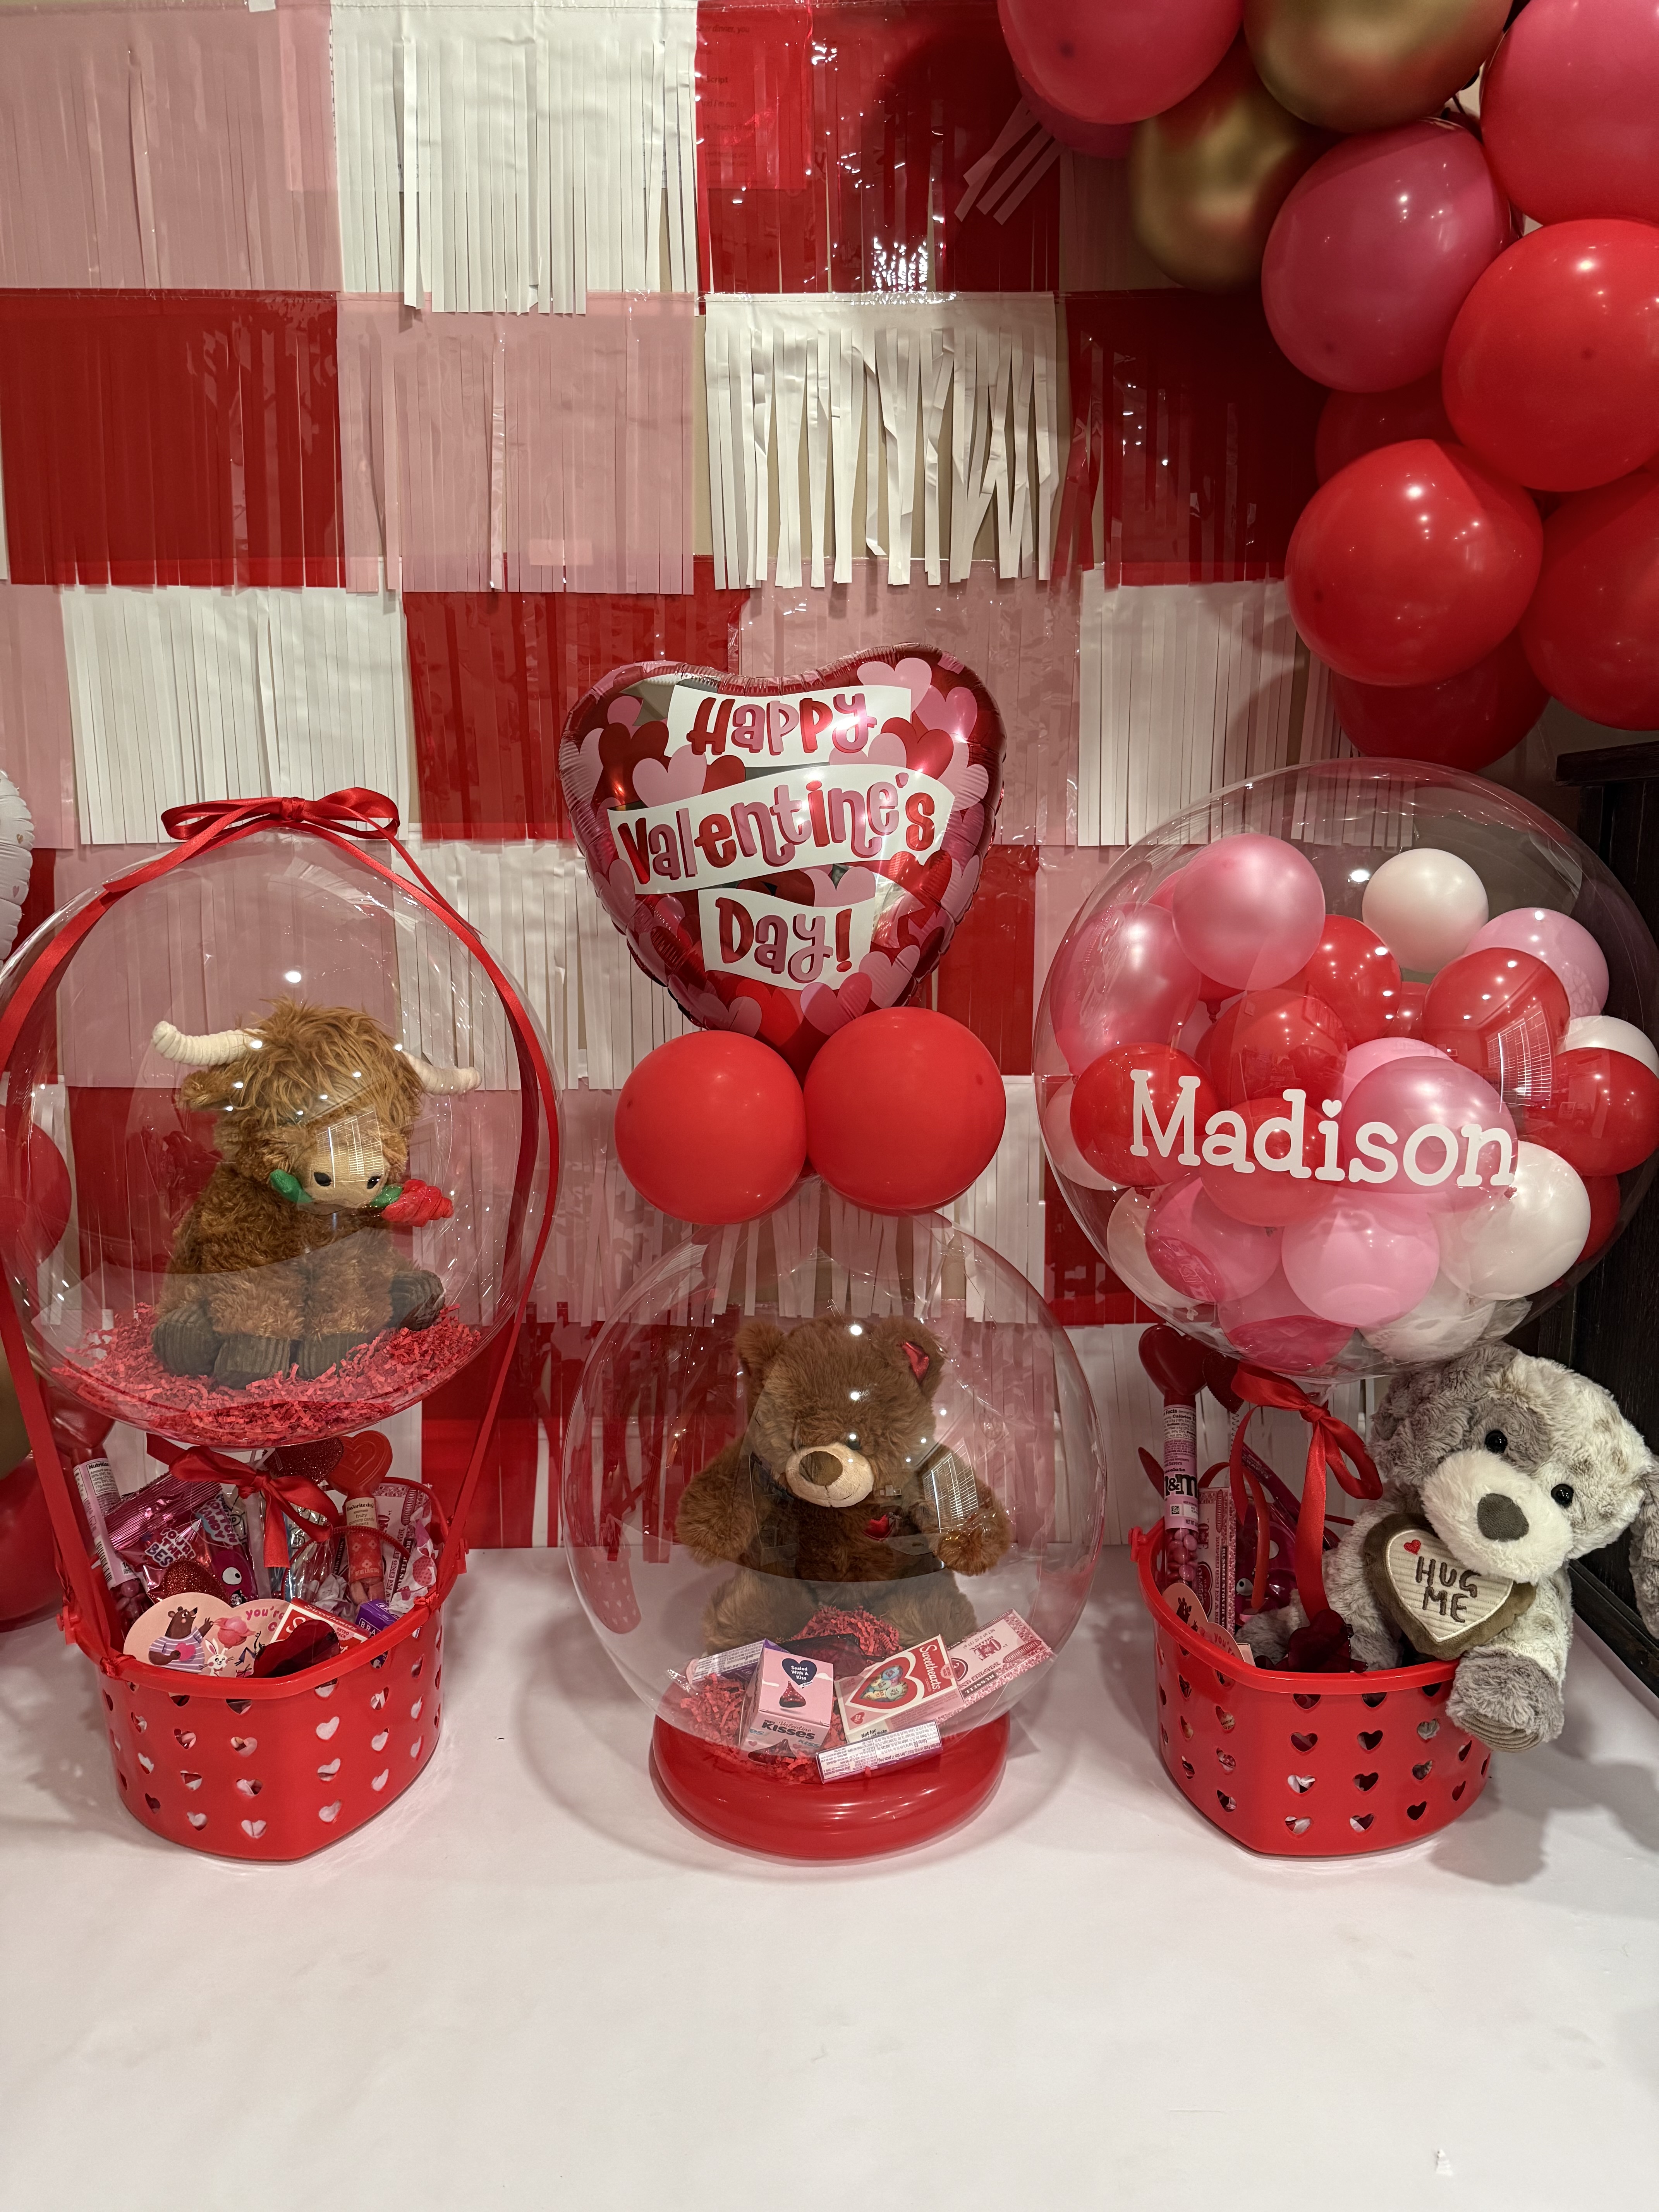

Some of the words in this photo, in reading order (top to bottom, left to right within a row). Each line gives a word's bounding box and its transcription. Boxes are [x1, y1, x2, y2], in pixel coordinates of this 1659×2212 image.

[618, 773, 934, 884] Valentine's
[715, 898, 852, 984] Day!
[1130, 1069, 1514, 1186] Madison
[146, 1543, 173, 1566] BES
[162, 1538, 182, 1559] THE
[1415, 1556, 1481, 1598] HUG
[304, 1604, 357, 1631] Sweethearts
[1422, 1587, 1469, 1623] ME
[974, 1639, 1001, 1661] ONE
[919, 1645, 941, 1690] Sweethearts
[964, 1674, 995, 1694] RUSSELL
[778, 1721, 812, 1733] Valentine
